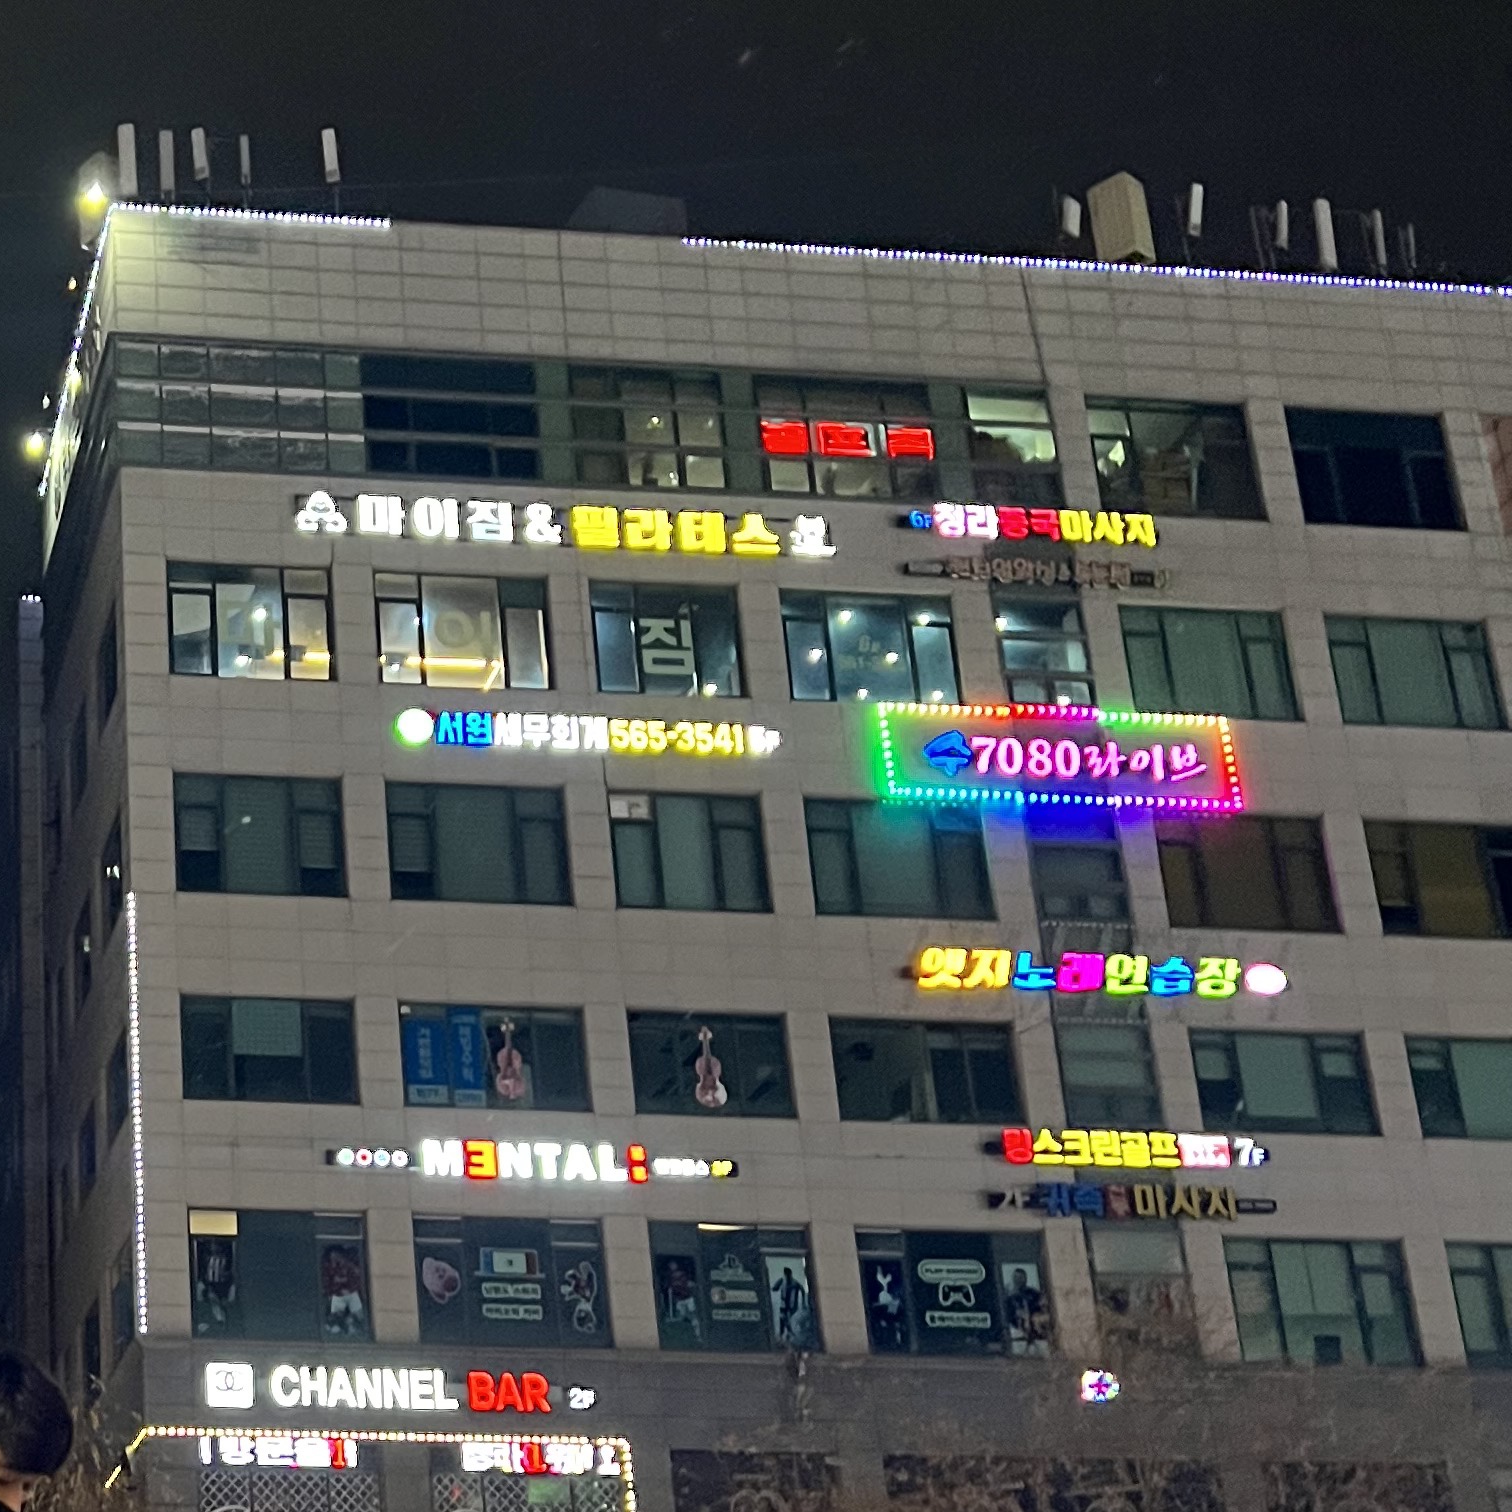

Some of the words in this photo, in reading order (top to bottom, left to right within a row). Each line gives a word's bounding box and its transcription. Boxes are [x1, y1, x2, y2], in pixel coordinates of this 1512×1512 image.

[570, 502, 782, 557] 필라테스
[609, 718, 746, 756] 565-3541
[270, 1364, 460, 1411] CHANNEL
[466, 1368, 552, 1414] BAR
